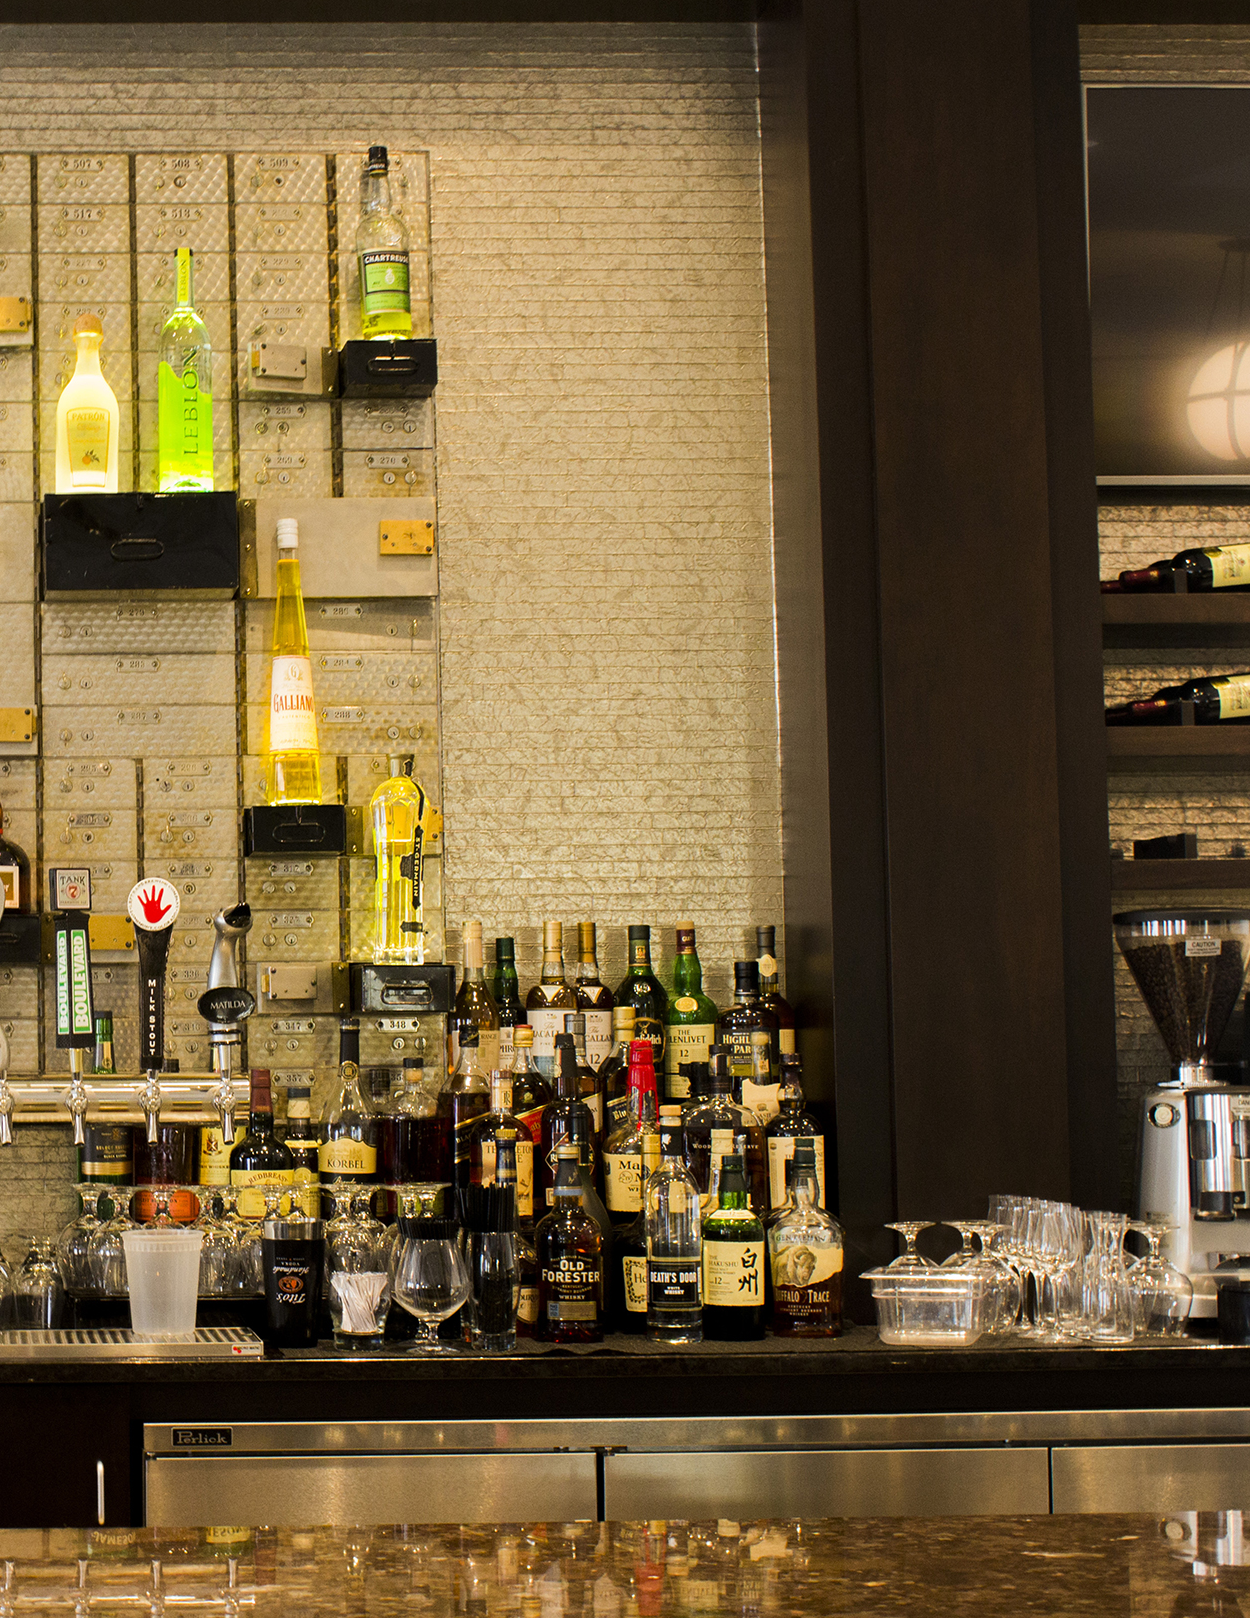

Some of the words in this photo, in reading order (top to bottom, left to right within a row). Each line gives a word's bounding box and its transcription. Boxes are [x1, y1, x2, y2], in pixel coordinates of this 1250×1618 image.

[74, 159, 93, 168] 507
[172, 159, 190, 167] 508
[270, 158, 288, 167] 509
[73, 208, 92, 217] 517
[183, 347, 199, 455] LEBLON
[71, 411, 105, 421] PATRÓN
[60, 876, 86, 886] TANK
[68, 886, 78, 898] 7
[58, 936, 67, 1029] BOULEVARD
[74, 936, 89, 1028] BOULEVARD
[148, 979, 156, 1011] MILK
[210, 1000, 246, 1010] MATILDA
[722, 1034, 751, 1044] HIGHL
[734, 1045, 751, 1054] PAR
[589, 1054, 601, 1065] 12
[486, 1145, 533, 1154] TEETON
[327, 1158, 366, 1169] KORBEL
[560, 1260, 584, 1271] OLD
[542, 1269, 600, 1283] FORESTER
[650, 1271, 677, 1283] DEATH'S
[679, 1271, 697, 1283] DOOR
[738, 1247, 759, 1296] 白州
[714, 1276, 723, 1285] 12
[807, 1289, 830, 1303] TRACE
[176, 1430, 228, 1444] Perlick
